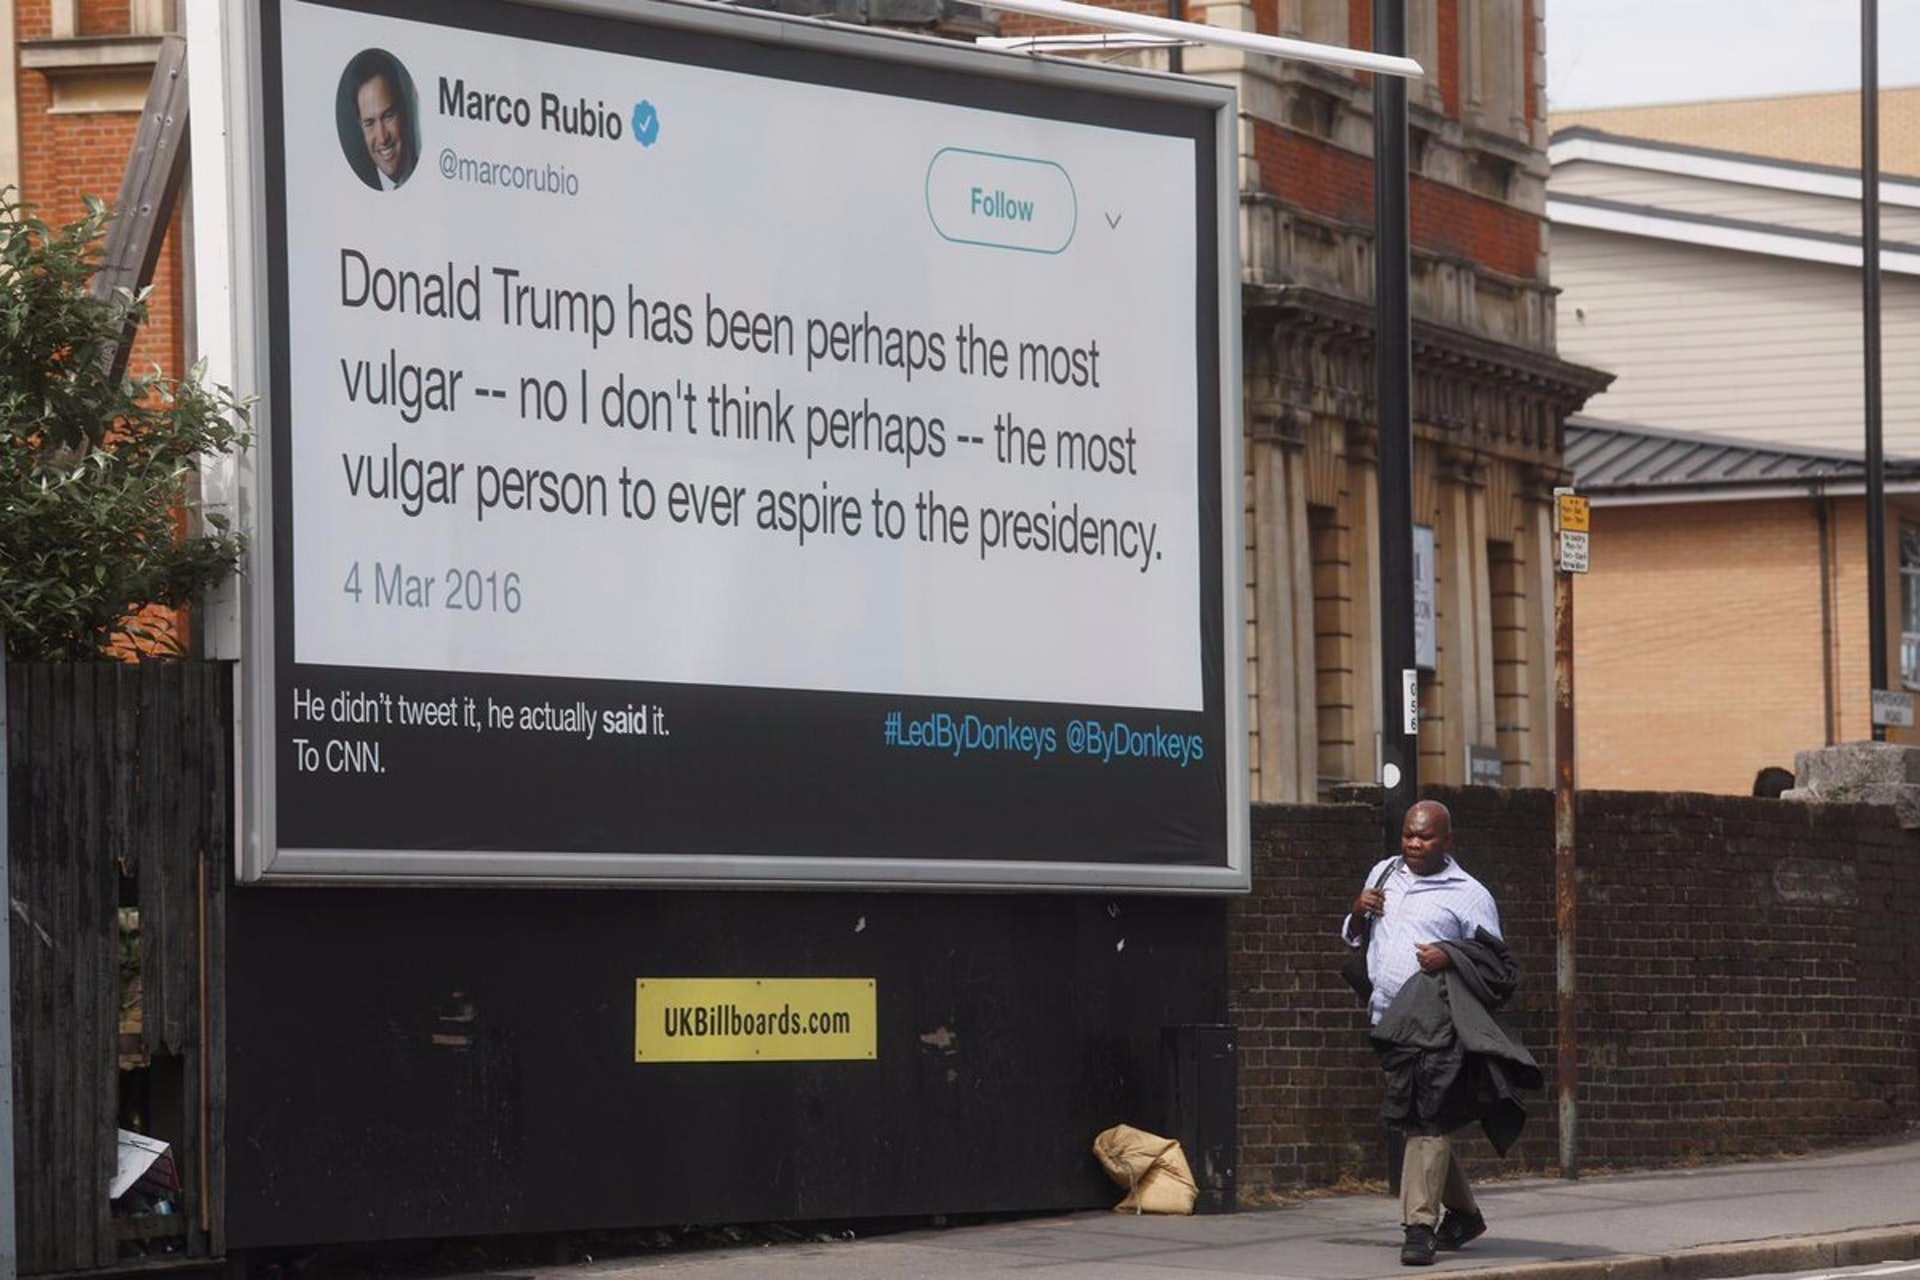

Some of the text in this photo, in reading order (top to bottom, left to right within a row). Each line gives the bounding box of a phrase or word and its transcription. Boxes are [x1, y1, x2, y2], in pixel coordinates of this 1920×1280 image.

[438, 76, 623, 141] Marco Rubio
[439, 148, 579, 196] @marcorubio
[970, 187, 1034, 222] Follow
[340, 248, 1100, 389] Donald Trump has been perhaps the most
[340, 348, 464, 424] vulgar
[520, 377, 568, 423] no
[581, 368, 588, 425] I
[601, 372, 698, 436] don't
[706, 383, 796, 444] think
[806, 397, 947, 470] perhaps
[993, 413, 1047, 468] the
[1056, 427, 1137, 476] most
[341, 442, 1162, 574] vulgar person to ever aspire to the presidency.
[344, 562, 521, 614] 4 Mar 2016
[293, 688, 326, 721] He
[397, 692, 459, 727] tweet
[463, 696, 482, 733] it,
[487, 697, 515, 730] he
[519, 701, 598, 741] actually
[602, 704, 648, 736] said
[652, 706, 671, 737] it.
[884, 711, 1204, 768] #LedByDonkeys @ByDonkeys
[292, 738, 386, 774] To CNN.
[664, 1003, 850, 1038] UKBillboards.com
